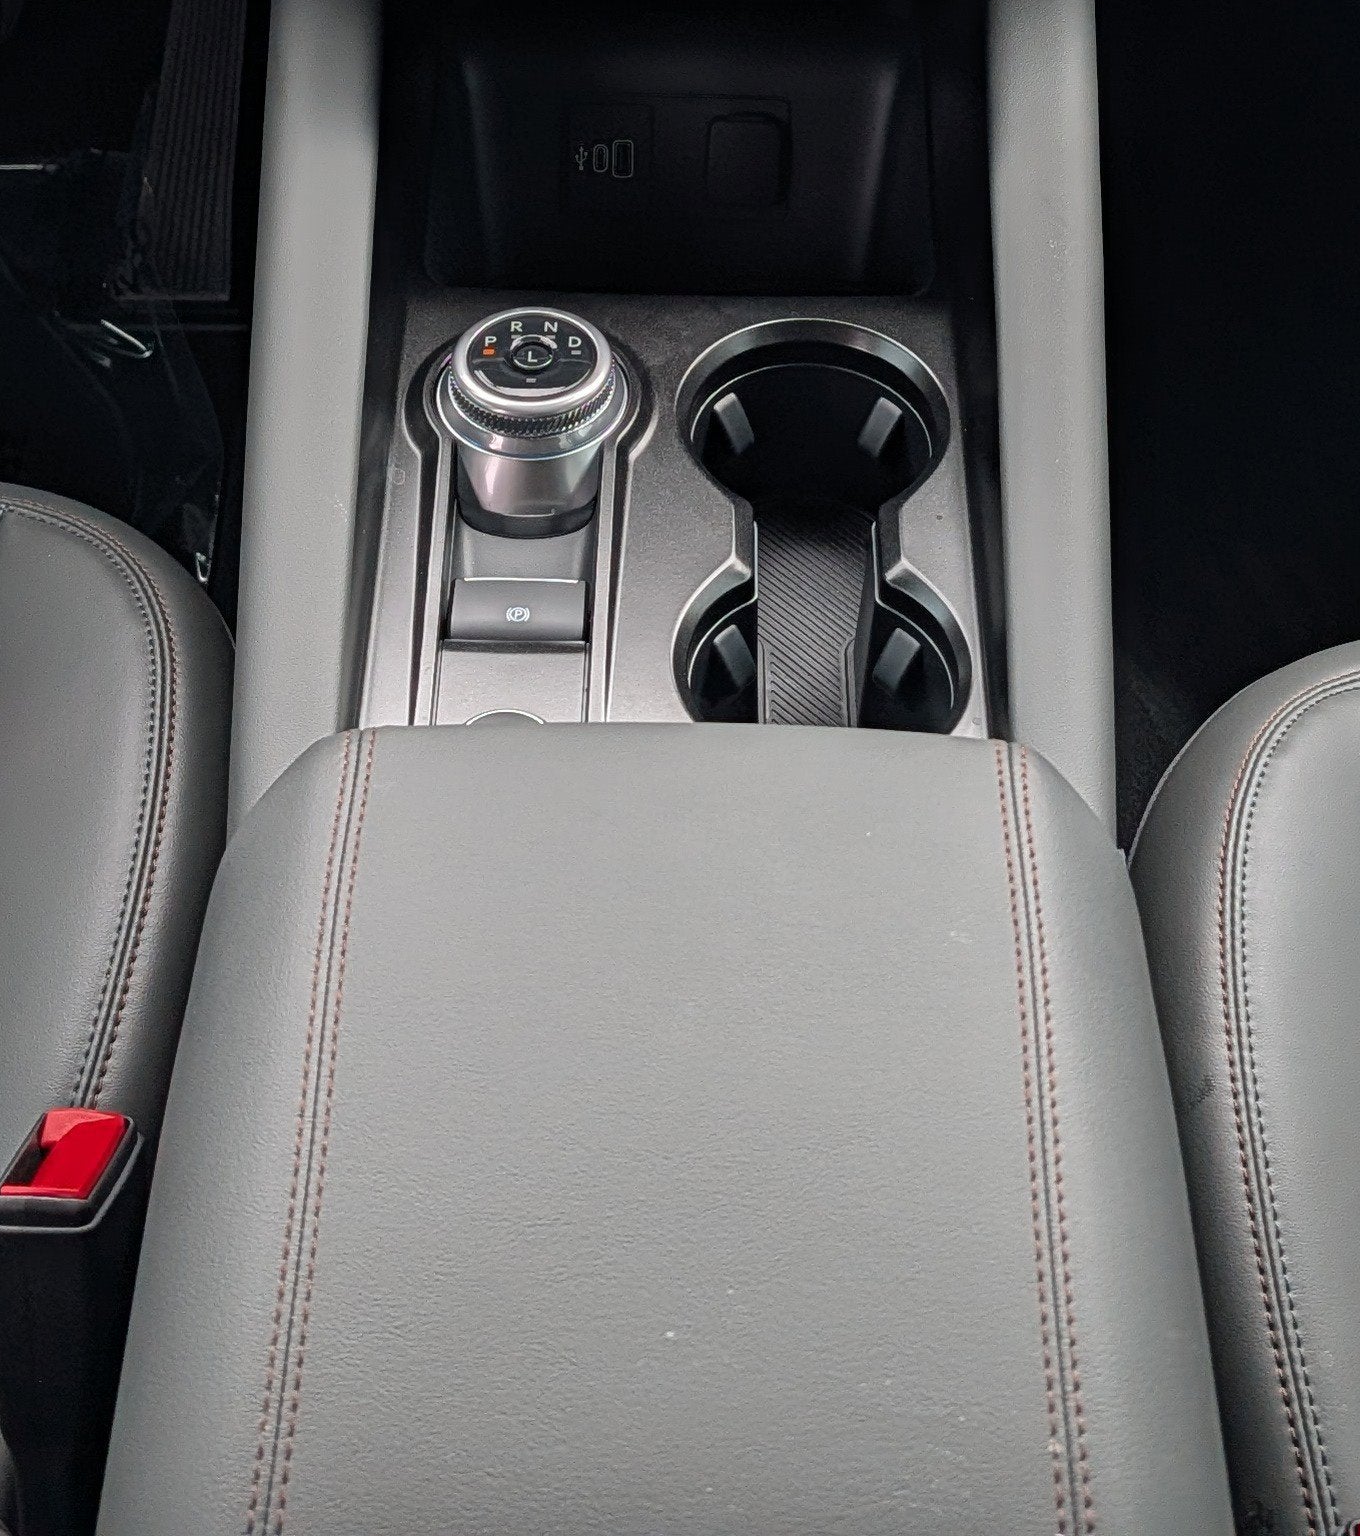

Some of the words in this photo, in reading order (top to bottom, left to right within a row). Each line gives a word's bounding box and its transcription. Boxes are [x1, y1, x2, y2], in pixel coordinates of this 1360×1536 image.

[510, 321, 523, 332] R
[544, 321, 558, 333] N
[485, 336, 497, 347] P
[568, 336, 581, 348] D
[527, 350, 538, 363] L
